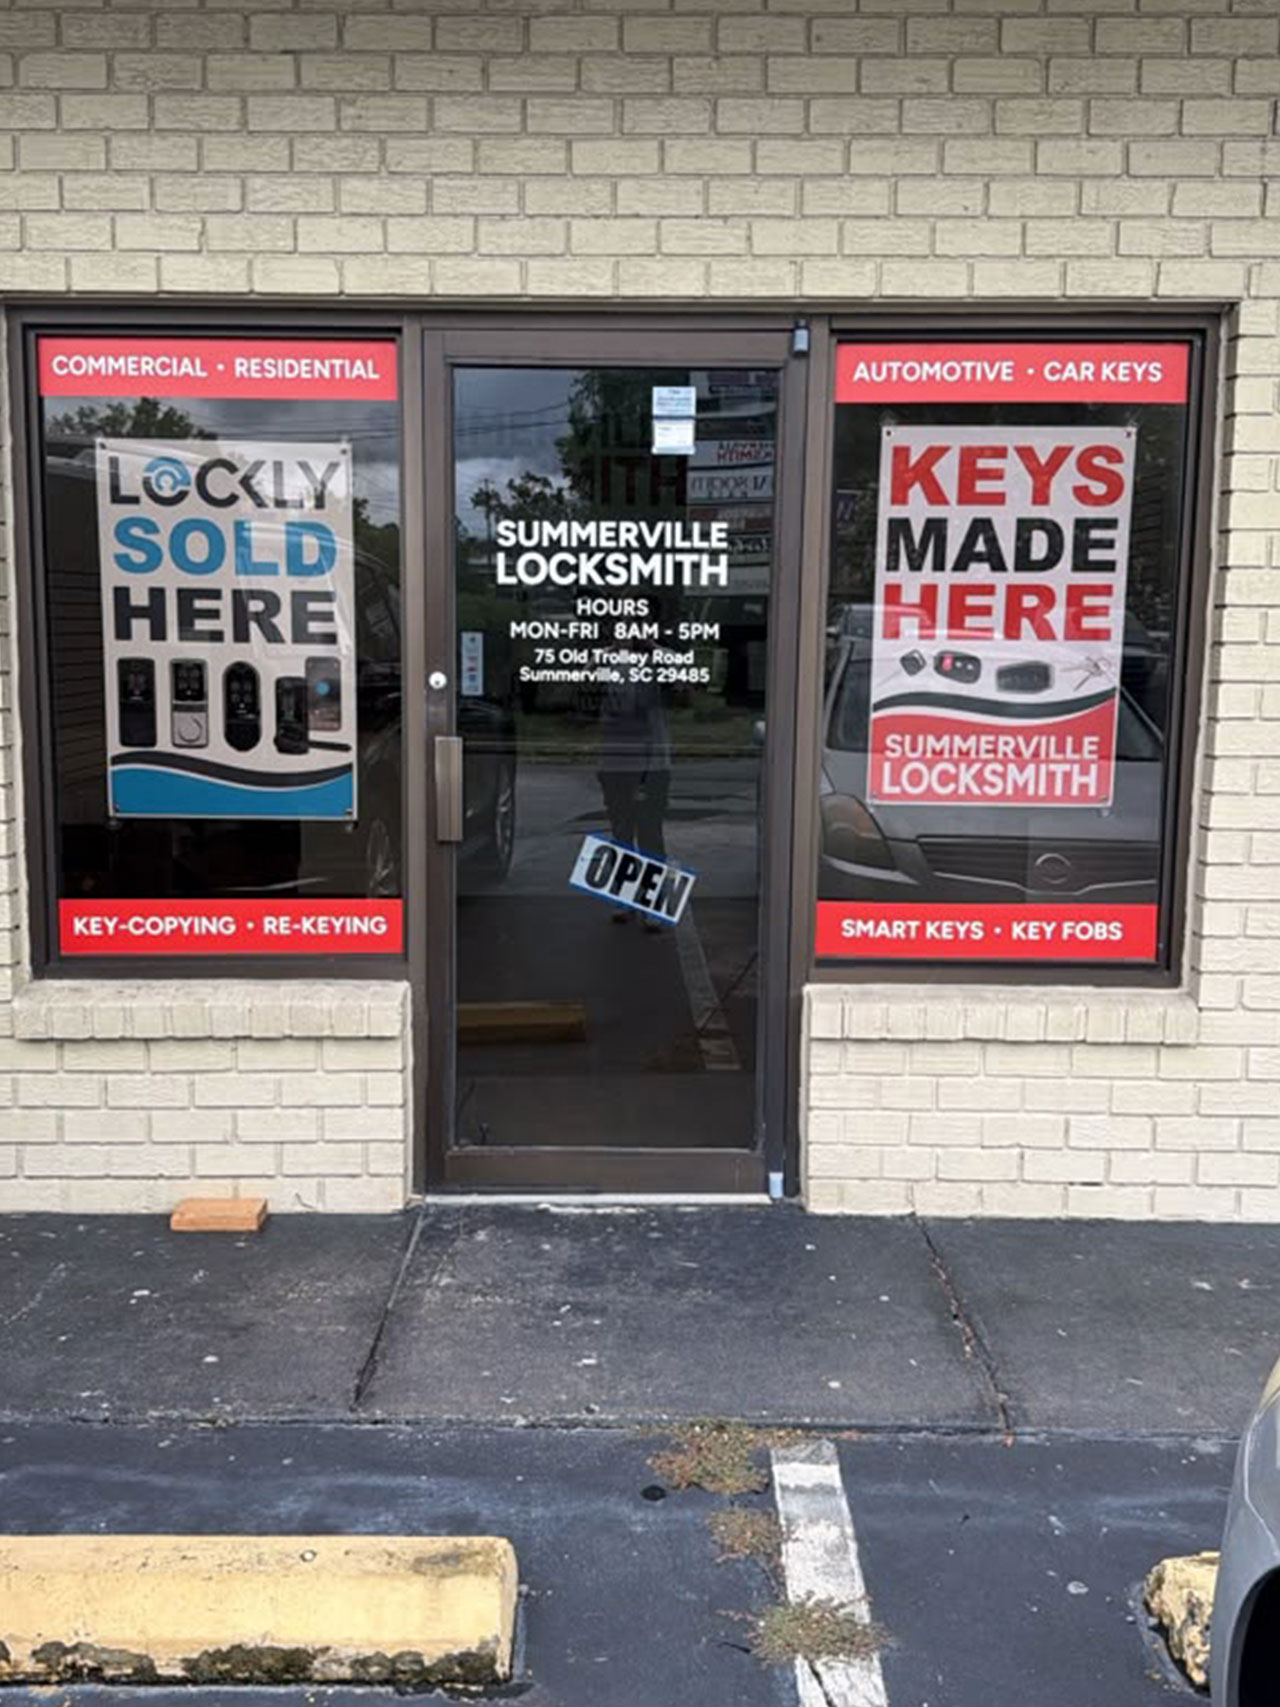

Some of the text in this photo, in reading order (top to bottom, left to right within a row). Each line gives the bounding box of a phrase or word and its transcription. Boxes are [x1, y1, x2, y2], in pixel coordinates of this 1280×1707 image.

[51, 355, 380, 380] COMMERCIAL RESIDENTIAL
[853, 361, 1163, 383] AUTOMOTIVE CAR KEYS
[108, 456, 341, 509] LOCKLY
[890, 445, 1125, 507] KEYS
[113, 516, 337, 577] SOLD
[496, 520, 728, 549] SUMMERVILLE
[885, 517, 1119, 573] MADE
[496, 552, 728, 586] LOCKSMITH
[112, 586, 338, 645] HERE
[577, 599, 649, 616] HOURS
[882, 583, 1114, 642] HERE
[510, 622, 599, 639] MON-FRI
[614, 623, 659, 639] 8AM
[678, 623, 720, 639] 5PM
[534, 649, 694, 666] 75 Old Trolley Road
[519, 667, 710, 684] Summerville, SC 29485
[884, 734, 1099, 759] SUMMERVILLE
[881, 762, 1097, 796] LOCKSMITH
[584, 844, 691, 917] OPEN
[73, 915, 388, 937] KEY-COPYING RE-KEYING
[841, 919, 1123, 940] SMART KEYS KEY FOBS
